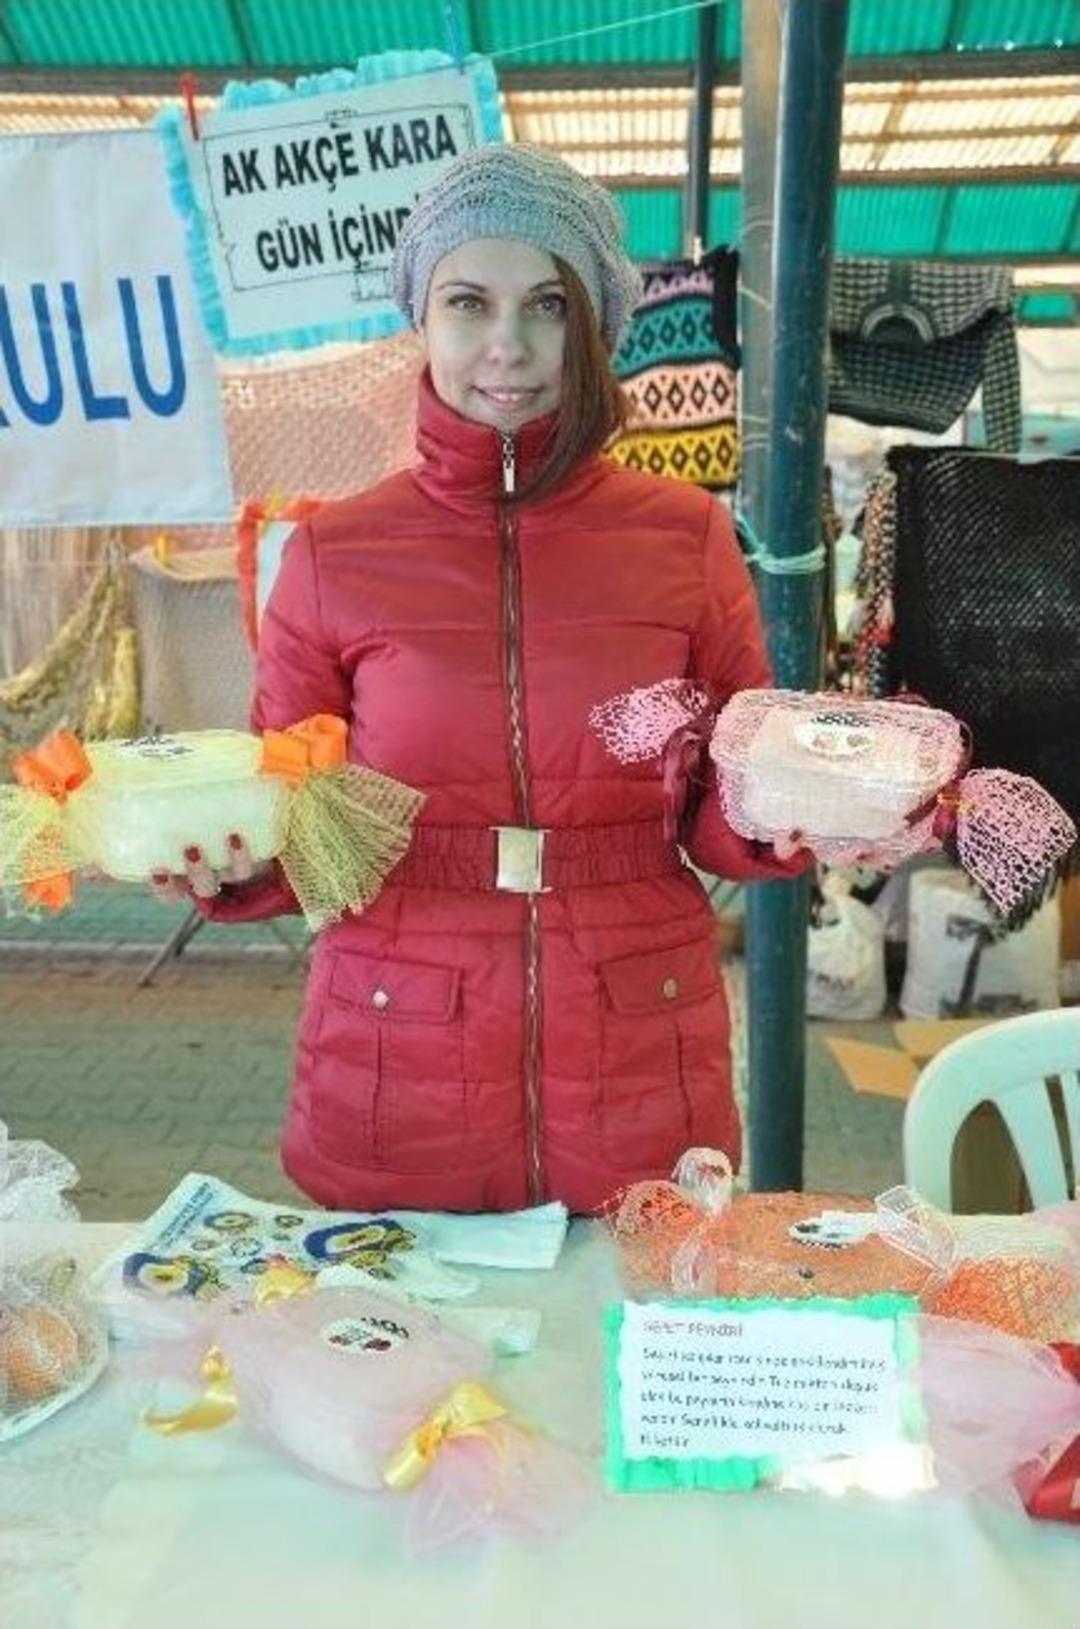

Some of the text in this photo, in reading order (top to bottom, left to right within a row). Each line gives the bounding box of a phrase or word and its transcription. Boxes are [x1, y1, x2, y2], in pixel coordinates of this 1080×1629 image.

[221, 114, 457, 196] AK AKÇE KARA
[256, 195, 419, 273] GÜN İÇİN
[0, 275, 186, 427] ULU
